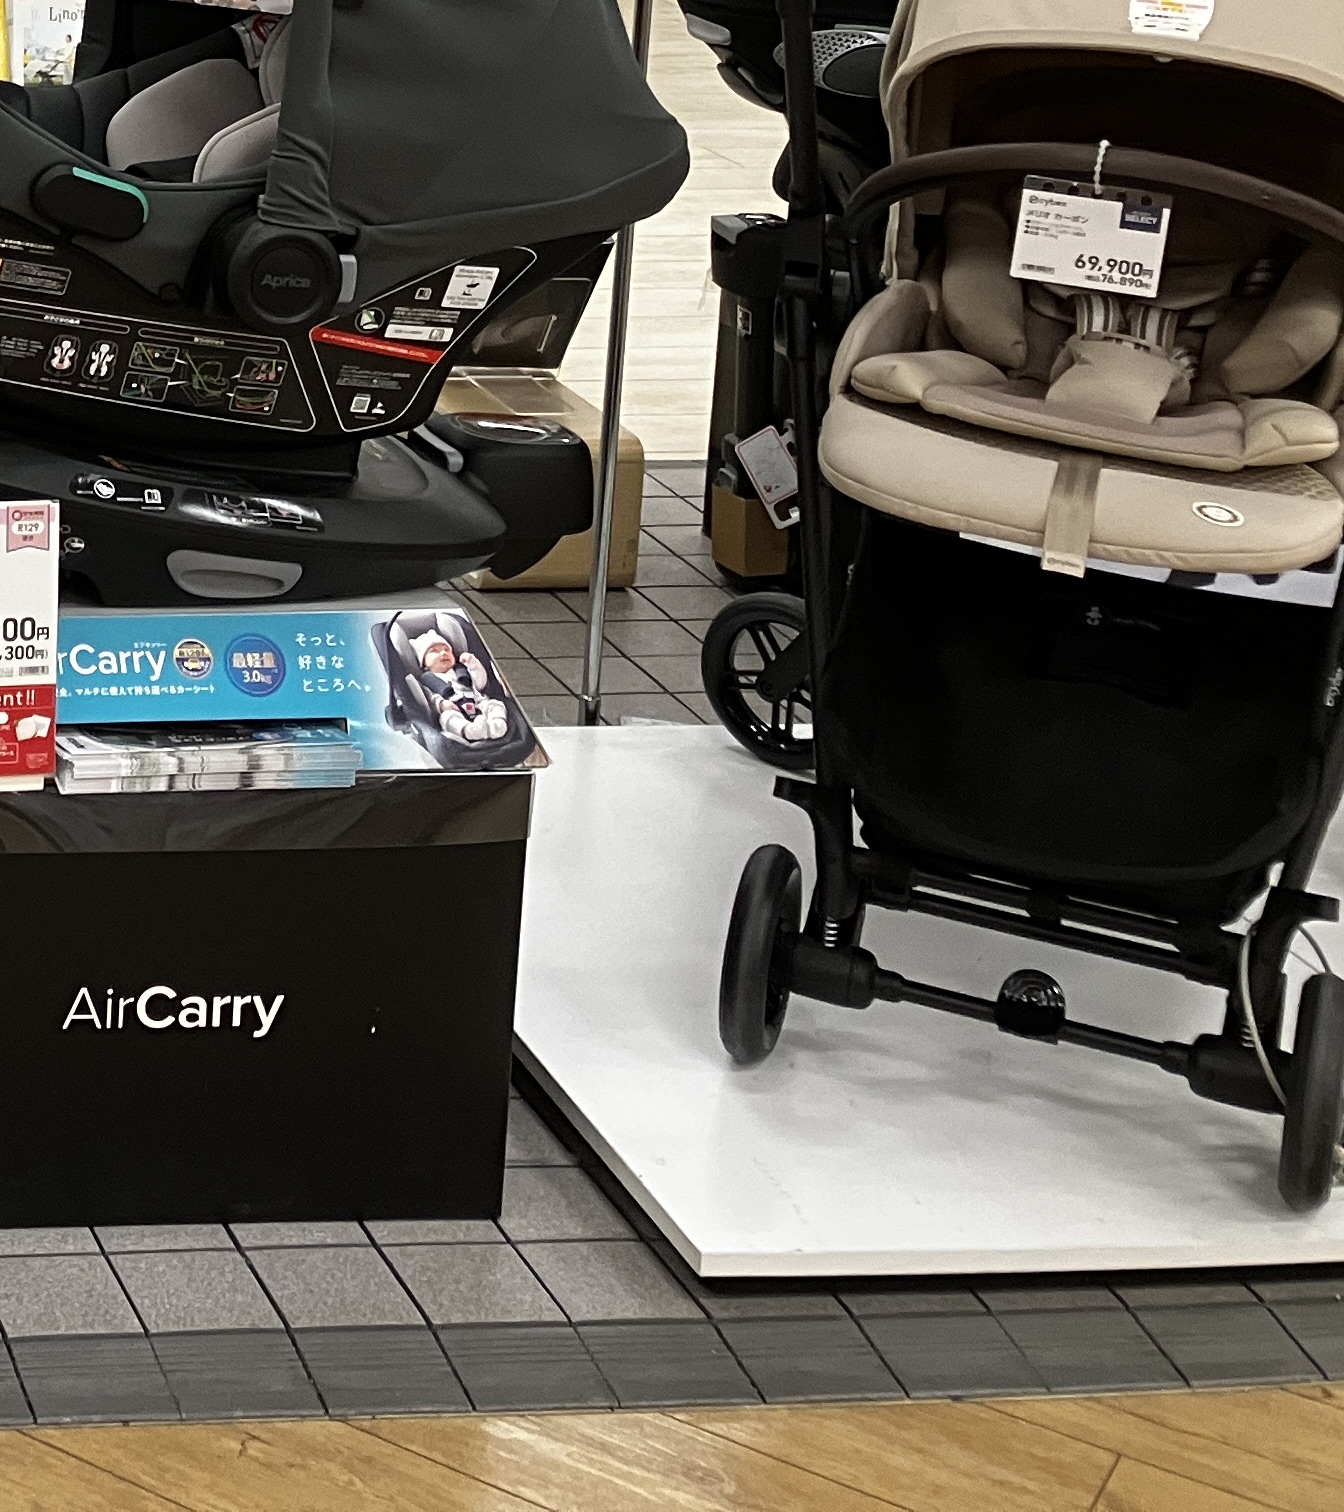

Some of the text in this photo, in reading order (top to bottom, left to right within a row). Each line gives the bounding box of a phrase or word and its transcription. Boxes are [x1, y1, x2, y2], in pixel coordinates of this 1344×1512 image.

[1074, 253, 1154, 279] 69,900円
[294, 631, 346, 647] そっと、
[58, 643, 167, 681] rCarry
[297, 655, 345, 671] 好きな
[301, 677, 371, 694] ところへ。
[62, 986, 285, 1038] AirCarry
